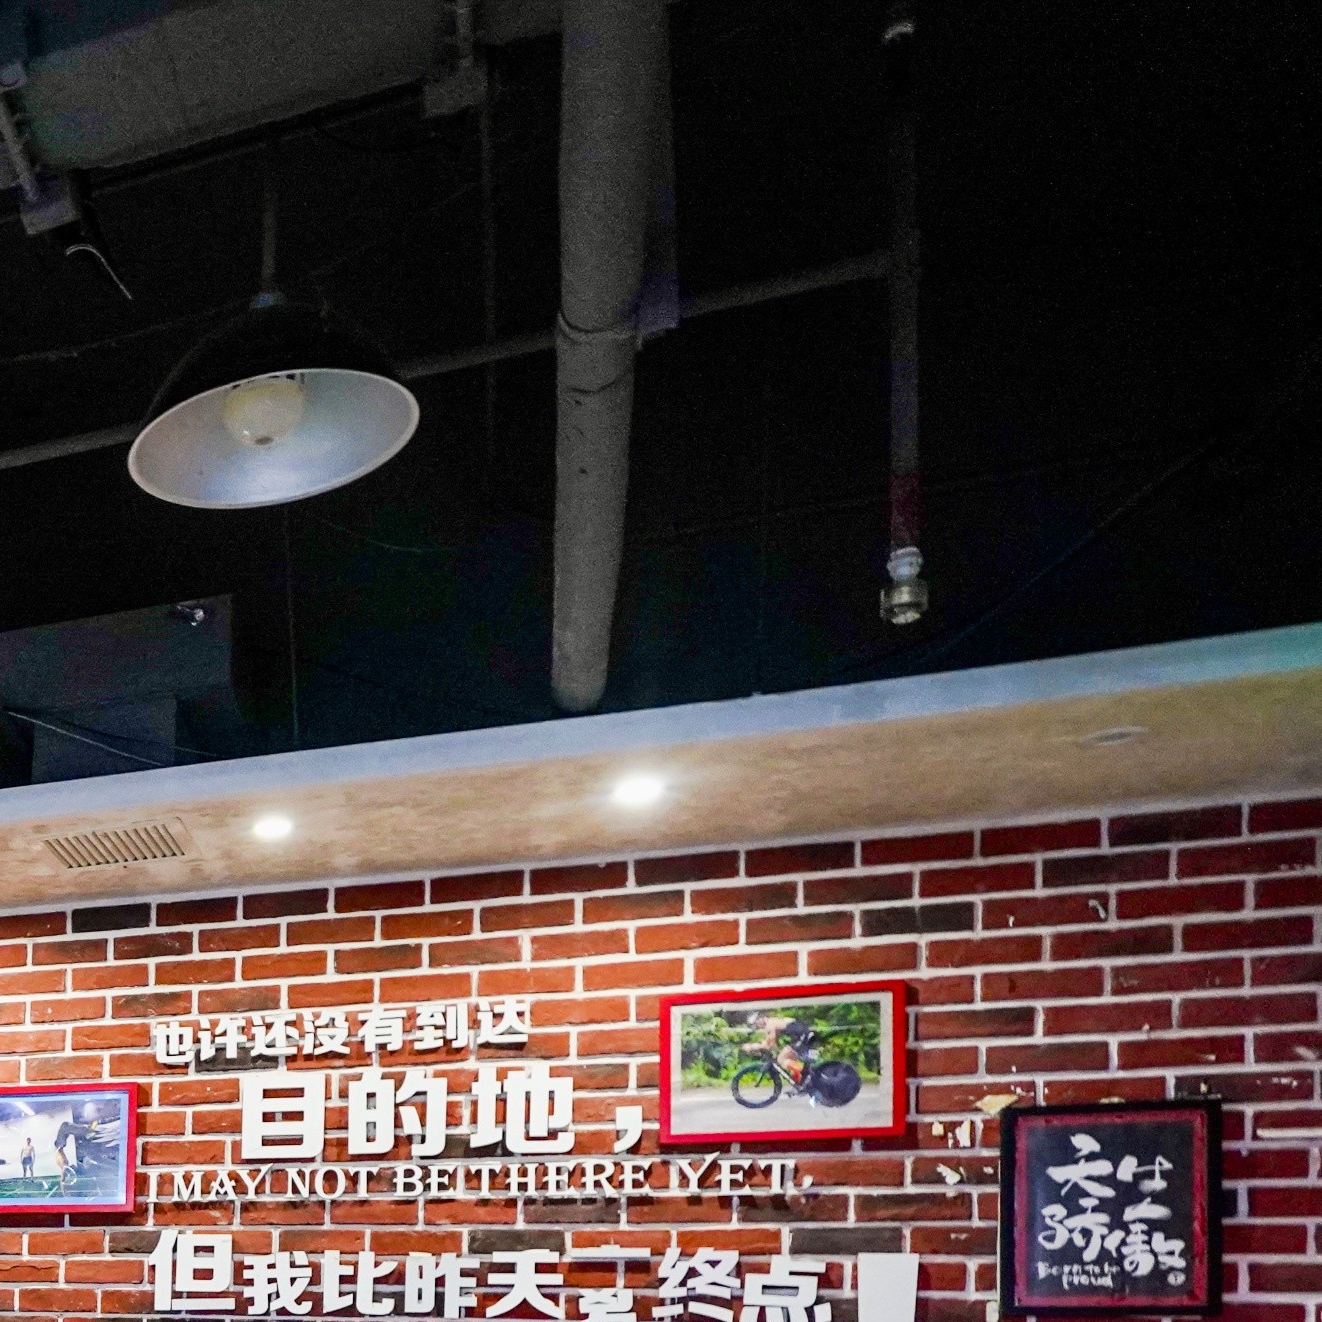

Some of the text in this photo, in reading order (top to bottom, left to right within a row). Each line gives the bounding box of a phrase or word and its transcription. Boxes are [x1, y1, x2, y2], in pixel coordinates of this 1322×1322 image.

[154, 998, 529, 1066] 也许还没有到达
[172, 1163, 274, 1202] MAY
[284, 1166, 381, 1200] NOT
[393, 1163, 459, 1198] BE
[469, 1158, 654, 1197] THERE
